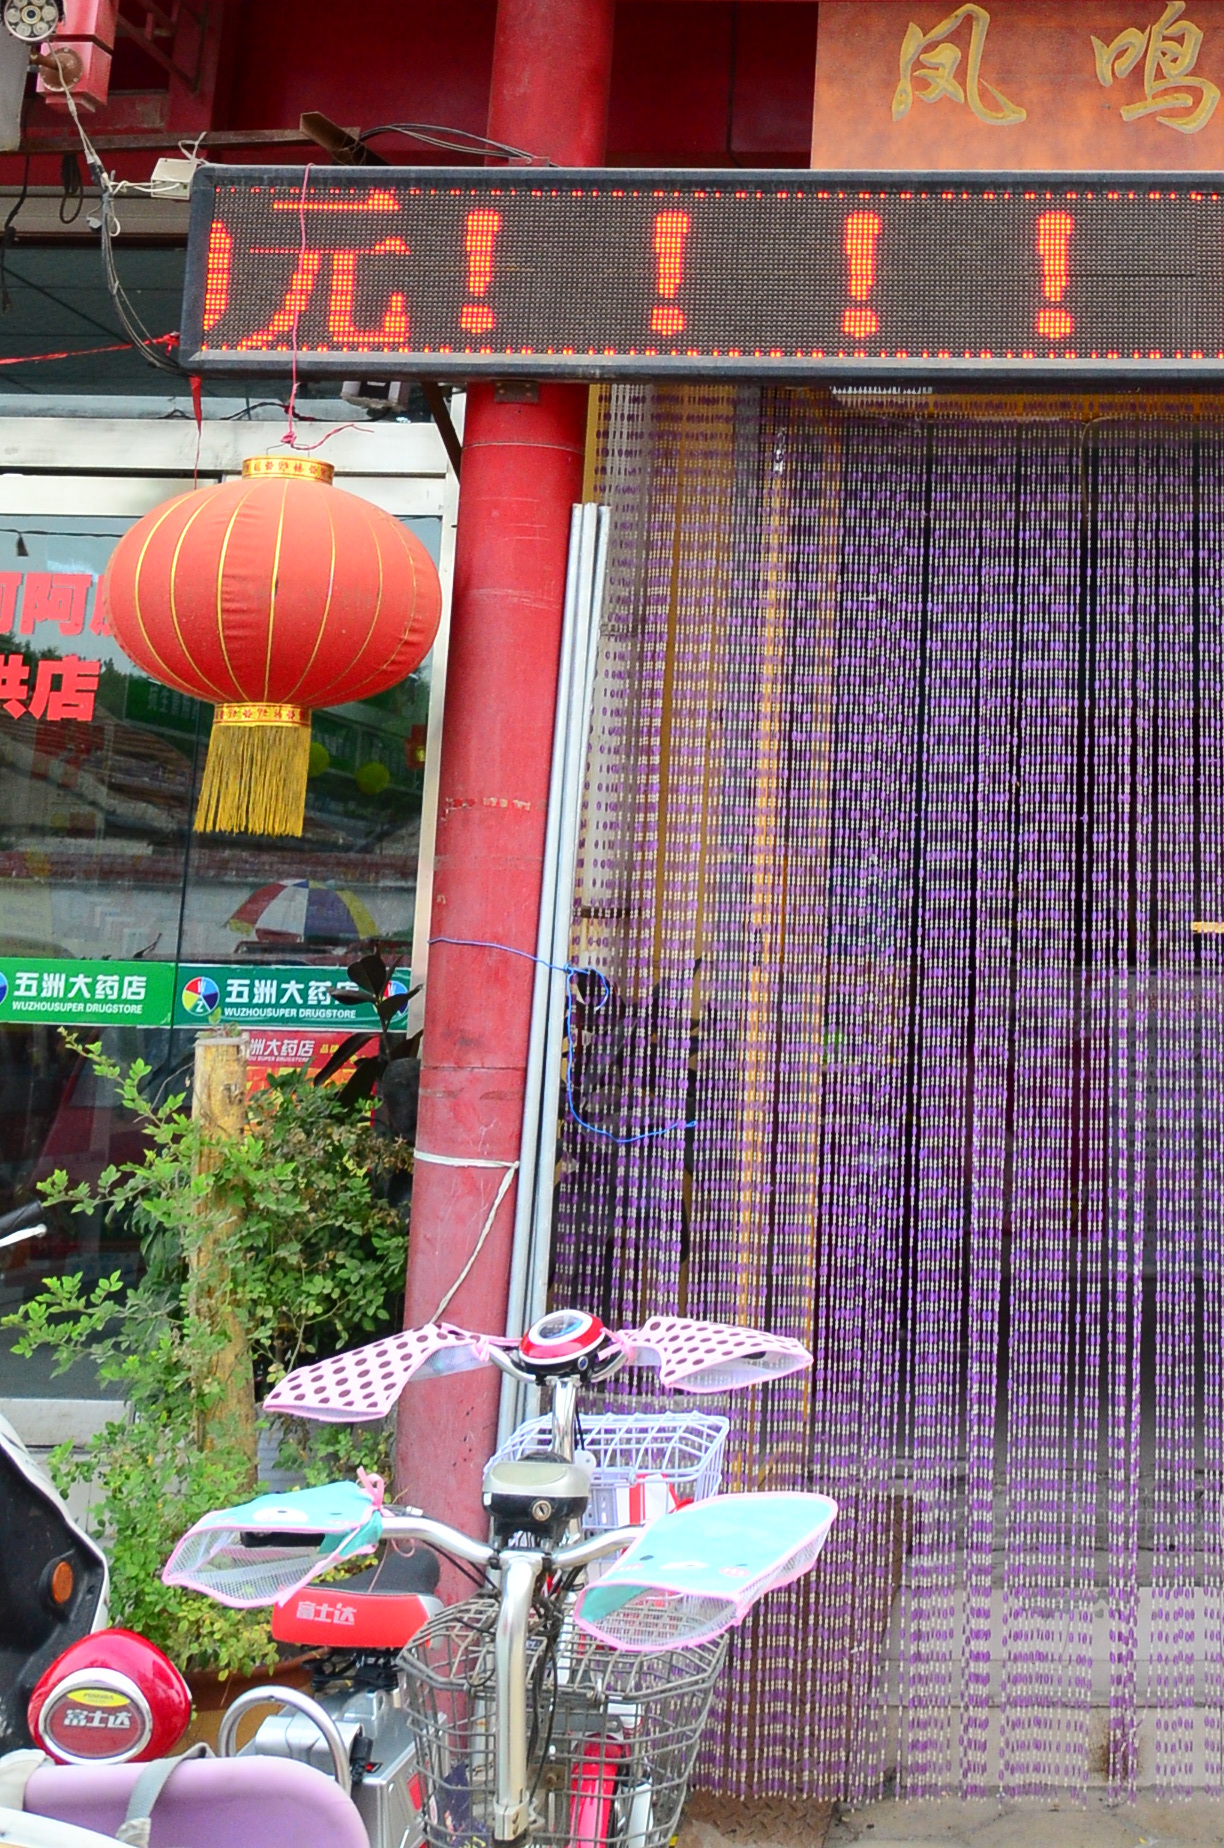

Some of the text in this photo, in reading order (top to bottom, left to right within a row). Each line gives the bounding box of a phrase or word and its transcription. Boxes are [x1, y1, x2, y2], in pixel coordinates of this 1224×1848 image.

[13, 971, 147, 1001] 五洲大药店
[12, 1001, 143, 1015] WUZHOUSUPER DRUGSTORE
[224, 1007, 357, 1019] WUZHOUSUPER DRUGSTORE
[296, 1601, 357, 1625] 富士达
[64, 1709, 132, 1729] 富士达
